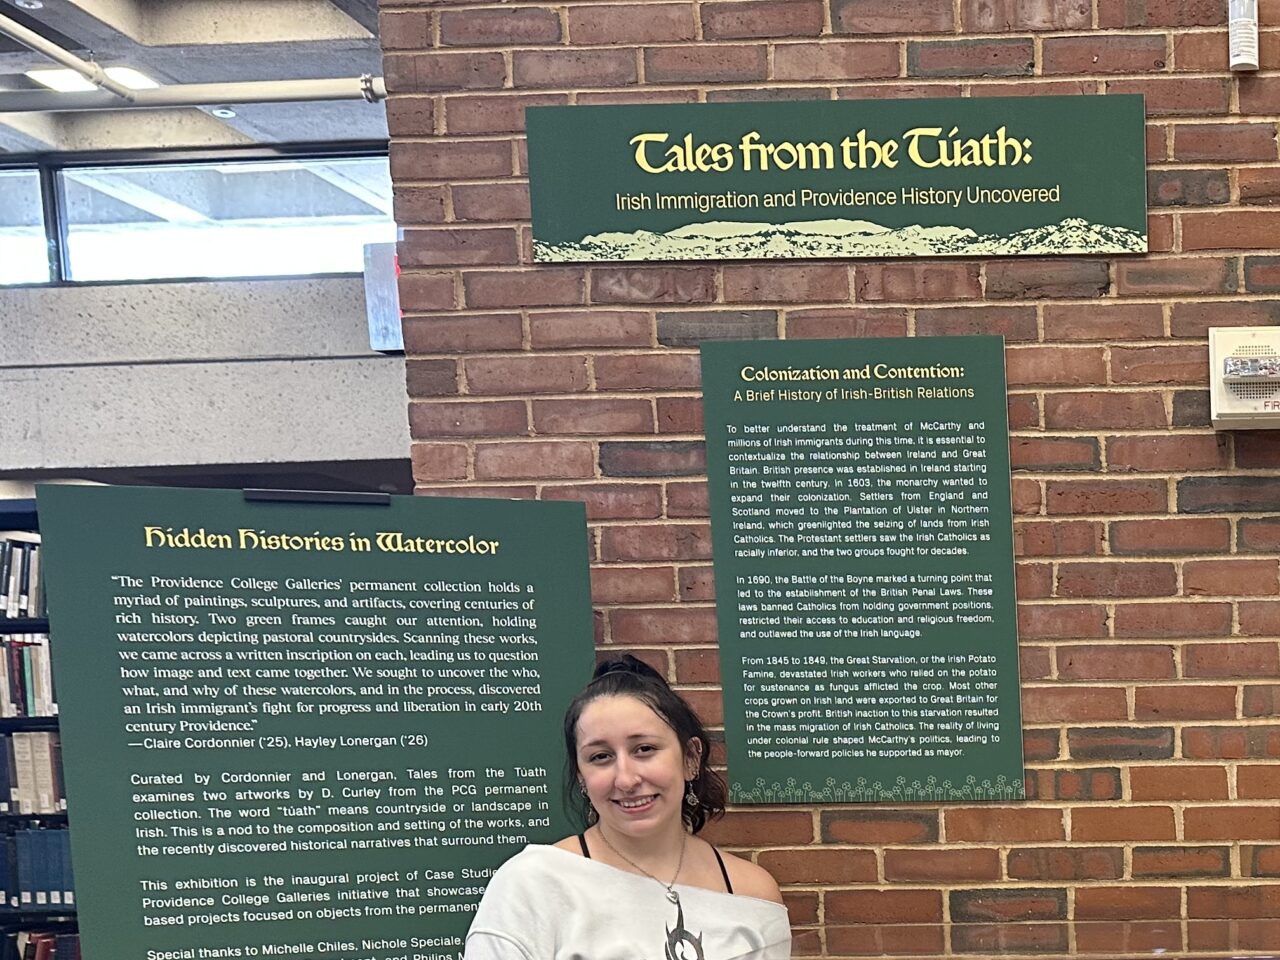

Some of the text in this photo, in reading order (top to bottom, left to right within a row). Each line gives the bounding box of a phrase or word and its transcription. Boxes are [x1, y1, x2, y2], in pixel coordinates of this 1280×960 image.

[629, 133, 734, 174] Tales
[738, 131, 835, 171] from
[840, 128, 899, 170] the
[616, 184, 1060, 213] Irish Immigration and Providence History Uncovered
[741, 365, 840, 382] Colonization
[843, 364, 871, 380] and
[734, 386, 975, 403] A Brief History of Irish-British Relations
[726, 421, 985, 434] To better understand the treatment of McCarthy and
[144, 526, 499, 555] Hidden Histories in Watercolor
[151, 576, 224, 589] Providence
[230, 577, 279, 592] College
[349, 582, 417, 593] permanent
[423, 581, 482, 592] collection
[488, 581, 521, 593] holds
[527, 584, 534, 593] a
[736, 576, 745, 584] In
[774, 575, 789, 584] the
[791, 575, 817, 584] Battle
[819, 574, 828, 584] of
[830, 575, 845, 584] the
[846, 574, 874, 585] Boyne
[875, 574, 908, 583] marked
[910, 575, 916, 583] a
[917, 574, 948, 585] turning
[950, 573, 973, 584] point
[974, 573, 993, 582] that
[113, 594, 162, 608] myriad
[165, 594, 180, 606] of
[324, 597, 348, 608] and
[409, 598, 462, 612] covering
[464, 599, 519, 610] centuries
[522, 599, 535, 610] of
[184, 737, 256, 749] Cordonnier
[294, 736, 337, 749] Hayley
[340, 736, 397, 748] Lonergan
[130, 773, 183, 785] Curated
[194, 773, 211, 786] by
[221, 772, 292, 783] Cordonnier
[302, 771, 326, 782] and
[406, 769, 438, 780] Tales
[448, 768, 476, 779] from
[485, 768, 505, 778] the
[139, 880, 168, 891] This
[175, 878, 239, 890] exhibition
[245, 877, 257, 887] is
[263, 876, 285, 887] the
[291, 873, 350, 887] inaugural
[356, 871, 400, 885] project
[406, 870, 418, 881] of
[425, 869, 455, 880] Case
